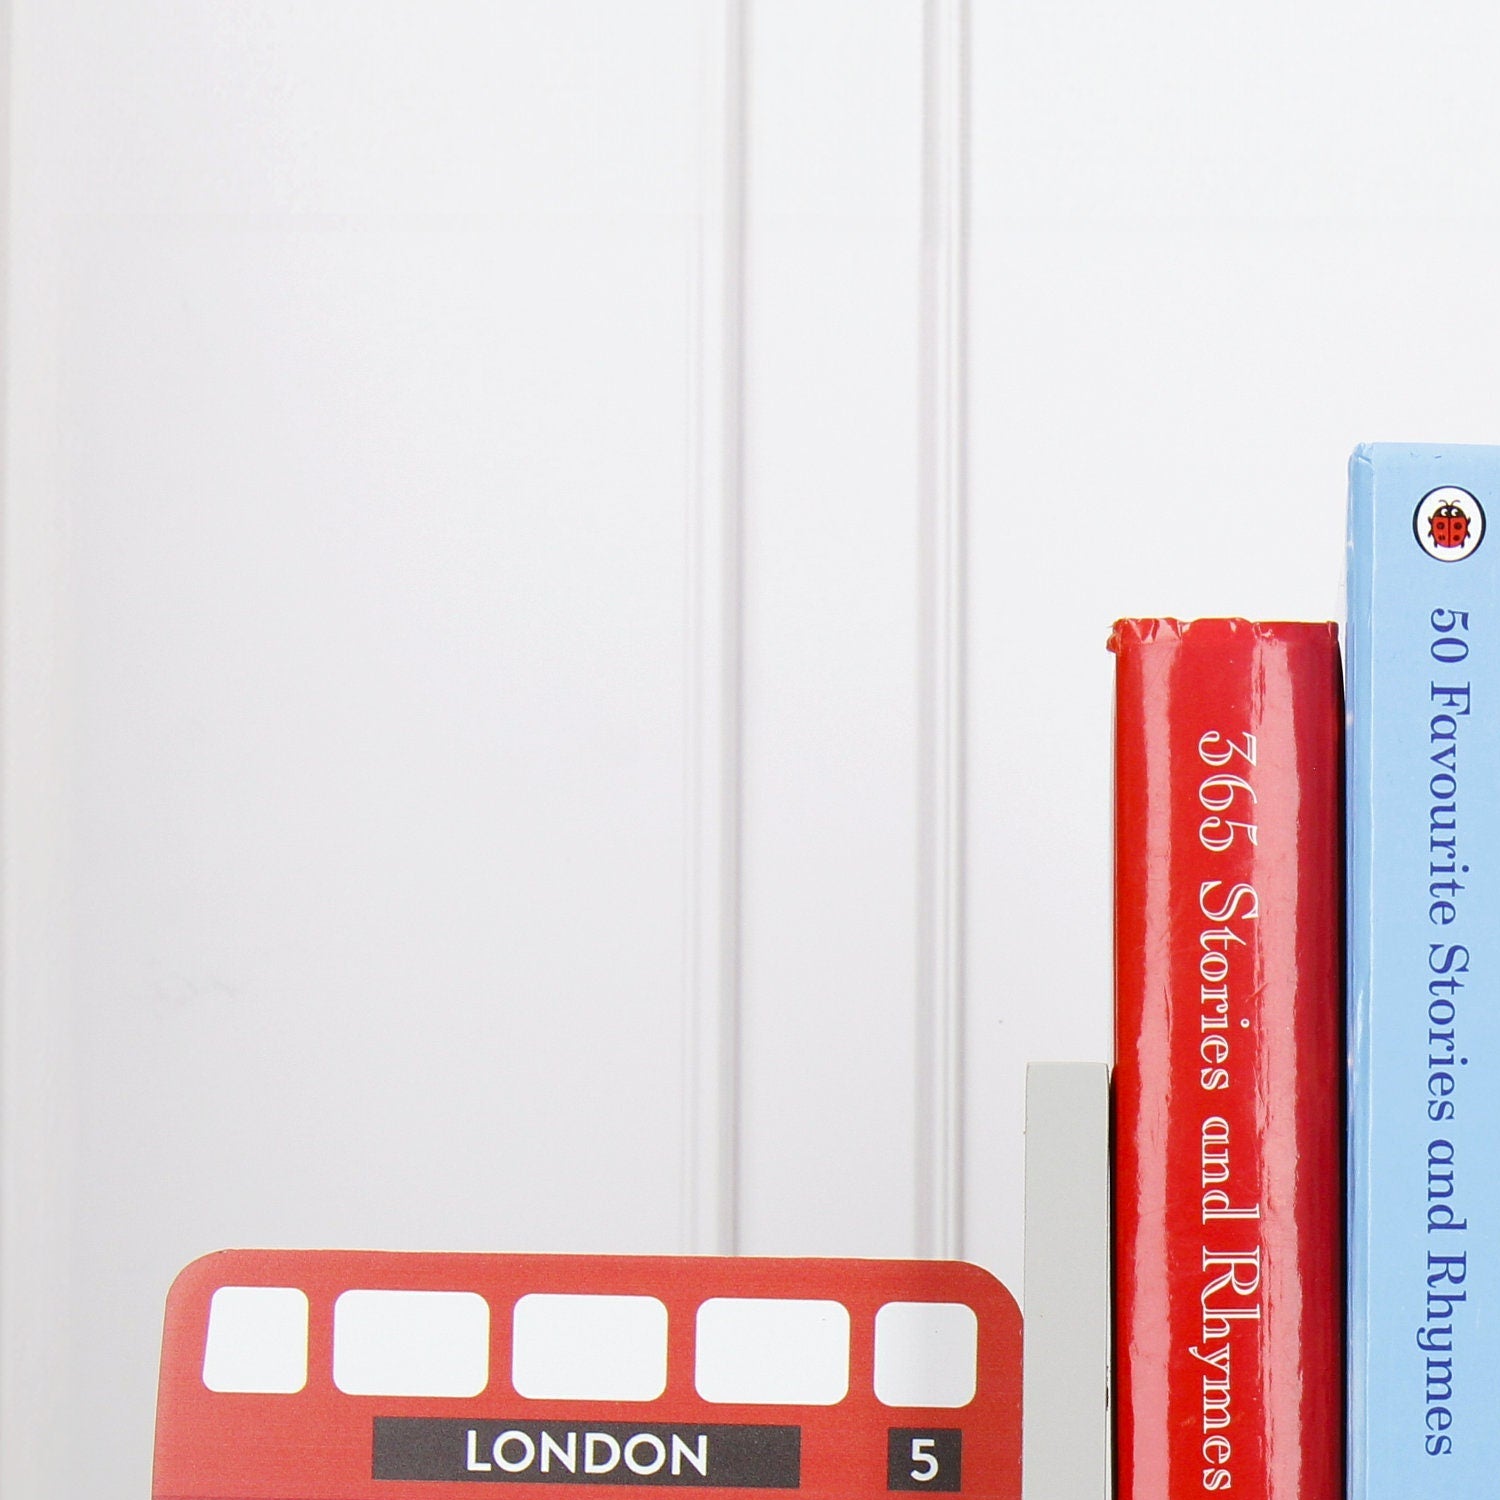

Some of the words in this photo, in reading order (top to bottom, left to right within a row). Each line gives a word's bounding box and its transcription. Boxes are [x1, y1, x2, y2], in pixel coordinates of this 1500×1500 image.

[1429, 607, 1470, 664] 50
[1199, 729, 1258, 852] 365
[1428, 681, 1471, 925] Favourite
[1200, 881, 1260, 1091] Stories
[1427, 943, 1470, 1122] Stories
[1202, 1116, 1261, 1224] and
[1427, 1139, 1468, 1234] and
[1189, 1246, 1261, 1491] Rhymes
[1416, 1250, 1467, 1456] Rhymes
[467, 1430, 708, 1477] LONDON
[911, 1439, 939, 1482] 5
